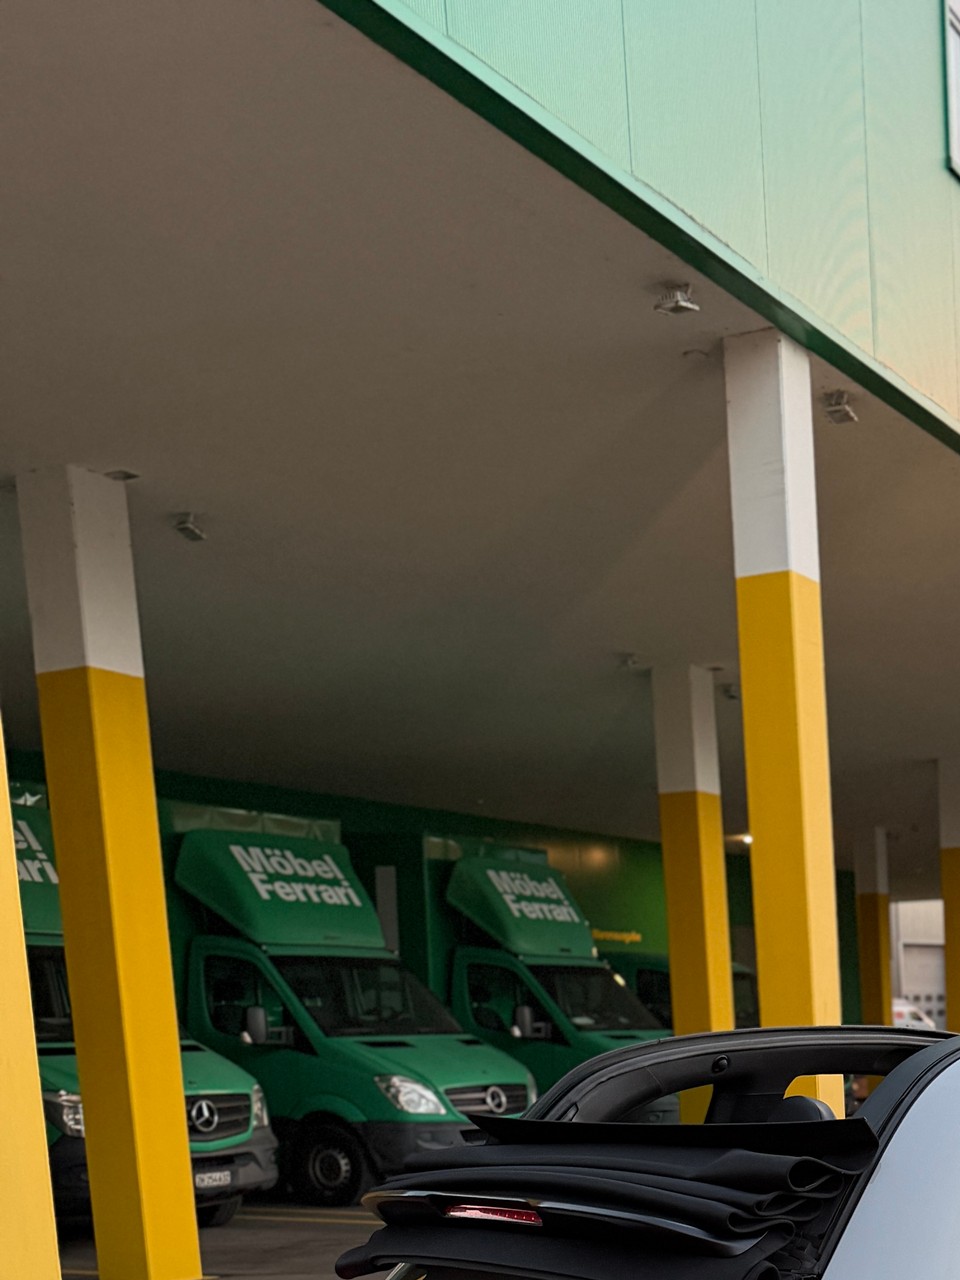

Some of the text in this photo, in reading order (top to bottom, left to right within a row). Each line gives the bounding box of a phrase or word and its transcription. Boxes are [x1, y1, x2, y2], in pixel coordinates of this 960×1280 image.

[229, 845, 345, 880] Möbel
[248, 873, 362, 907] Ferrari
[486, 869, 565, 899] Möbel
[502, 894, 579, 923] Ferrari
